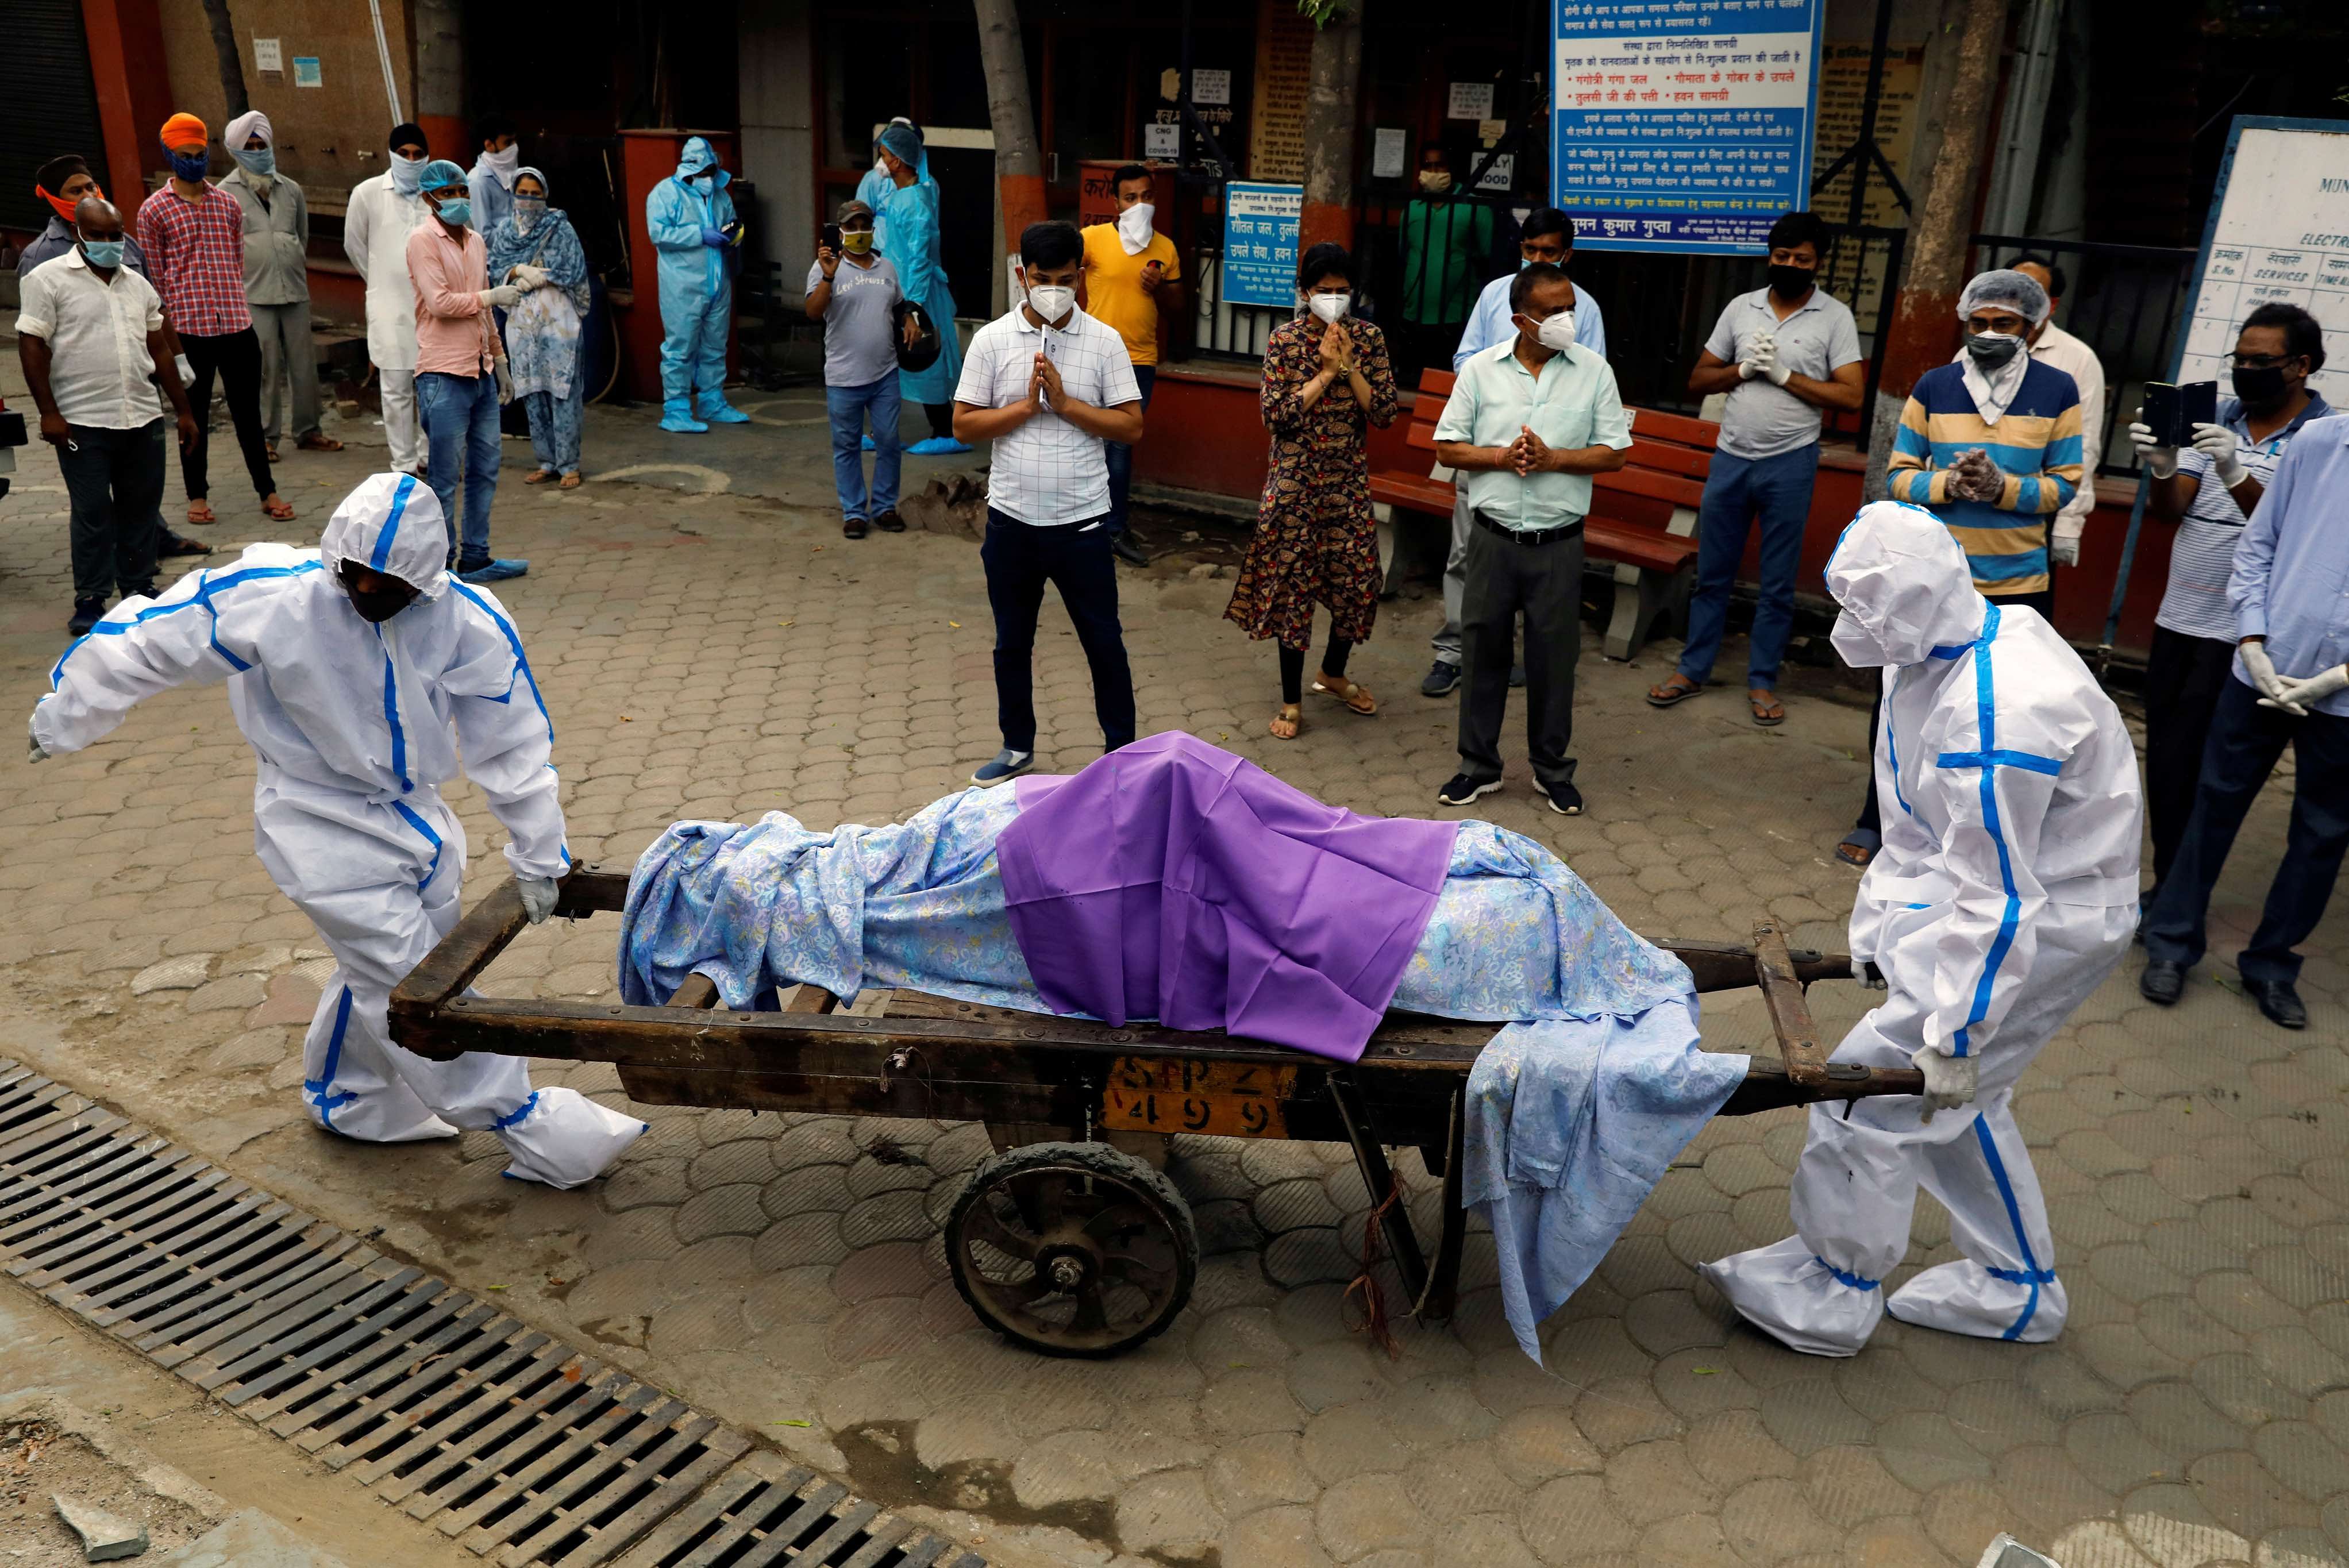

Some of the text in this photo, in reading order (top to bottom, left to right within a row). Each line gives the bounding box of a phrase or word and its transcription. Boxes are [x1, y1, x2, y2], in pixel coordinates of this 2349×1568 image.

[1576, 72, 1647, 84] गंगोत्री गंगा जल
[1674, 70, 1795, 83] गौमाता के गोबर के उपले
[1576, 89, 1658, 106] तुलसी जी की पत्ती
[1674, 88, 1729, 102] हवन सामग्री
[1484, 175, 1508, 184] OOD
[2254, 269, 2309, 282] SERVICES
[837, 273, 885, 295] Levi Strauss
